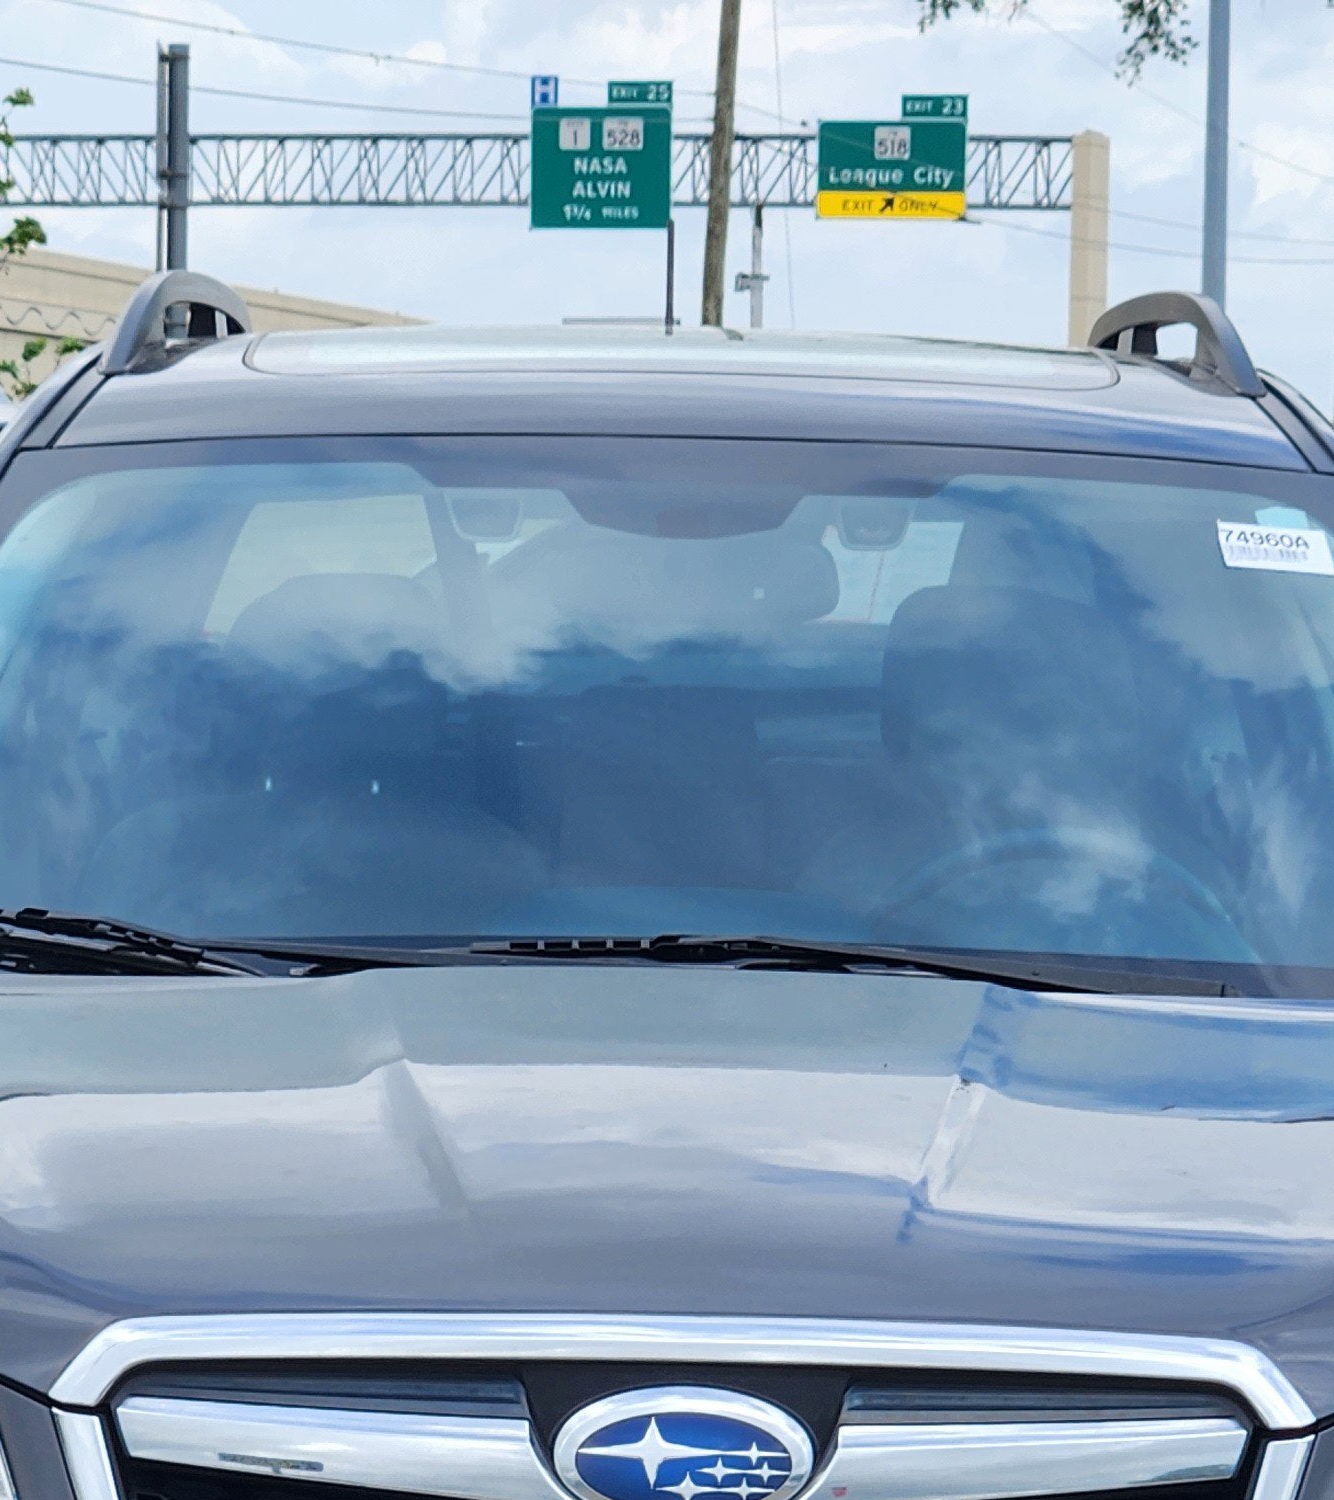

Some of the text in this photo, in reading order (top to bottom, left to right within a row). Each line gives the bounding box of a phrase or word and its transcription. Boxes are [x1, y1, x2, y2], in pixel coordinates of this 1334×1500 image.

[612, 85, 669, 100] EXIT 25
[905, 97, 964, 115] EXIT 23
[607, 128, 641, 146] 528
[877, 138, 908, 156] 518
[574, 156, 628, 175] NASA
[913, 166, 955, 189] City
[572, 180, 632, 198] ALVIN
[601, 205, 640, 220] MILES
[842, 199, 937, 211] EXIT ONLY
[1220, 528, 1310, 549] 74960A
